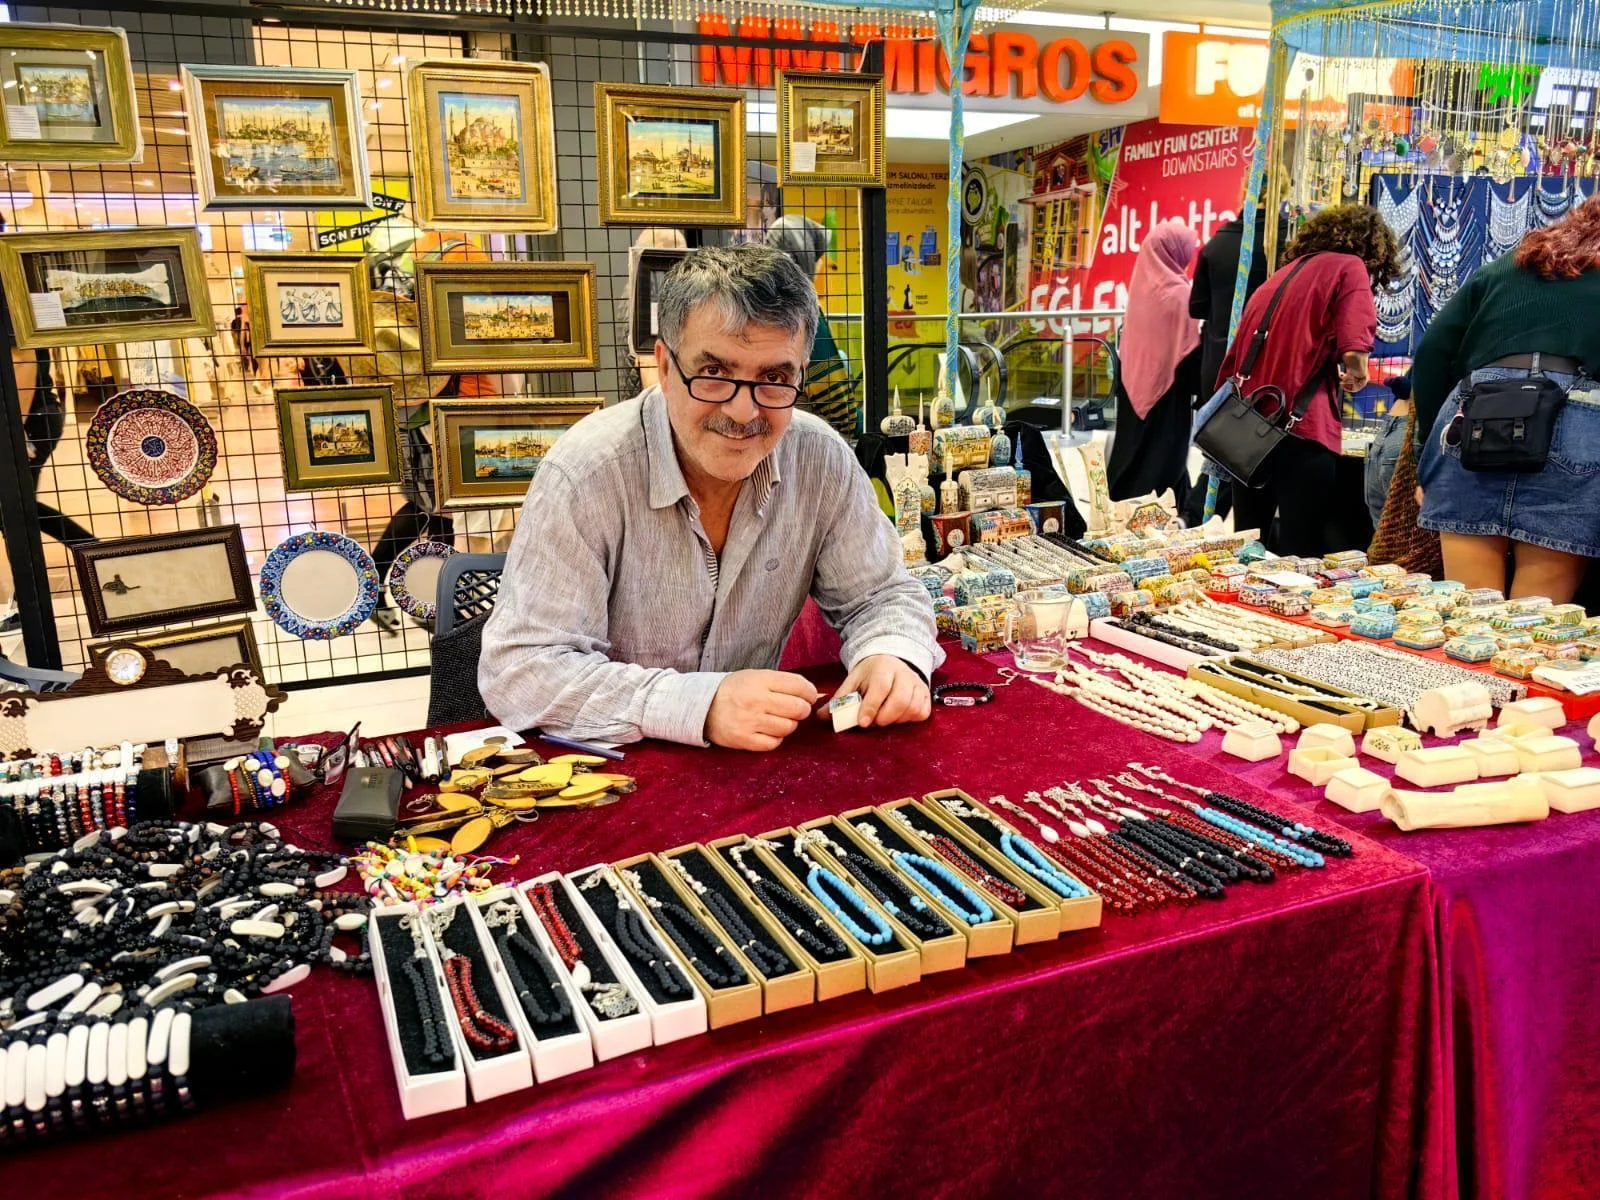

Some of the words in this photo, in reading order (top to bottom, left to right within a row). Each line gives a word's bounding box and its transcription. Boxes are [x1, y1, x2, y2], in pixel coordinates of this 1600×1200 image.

[1124, 140, 1163, 163] FAMILY
[1163, 132, 1188, 155] FUN
[1189, 126, 1239, 150] CENTER
[1162, 146, 1238, 178] DOWNSTAIRS
[887, 182, 937, 190] izmetinizdedir.
[374, 196, 392, 209] ON
[320, 230, 348, 246] SON
[351, 222, 378, 240] FIR
[1101, 204, 1142, 256] alt
[1150, 198, 1238, 249] ktt
